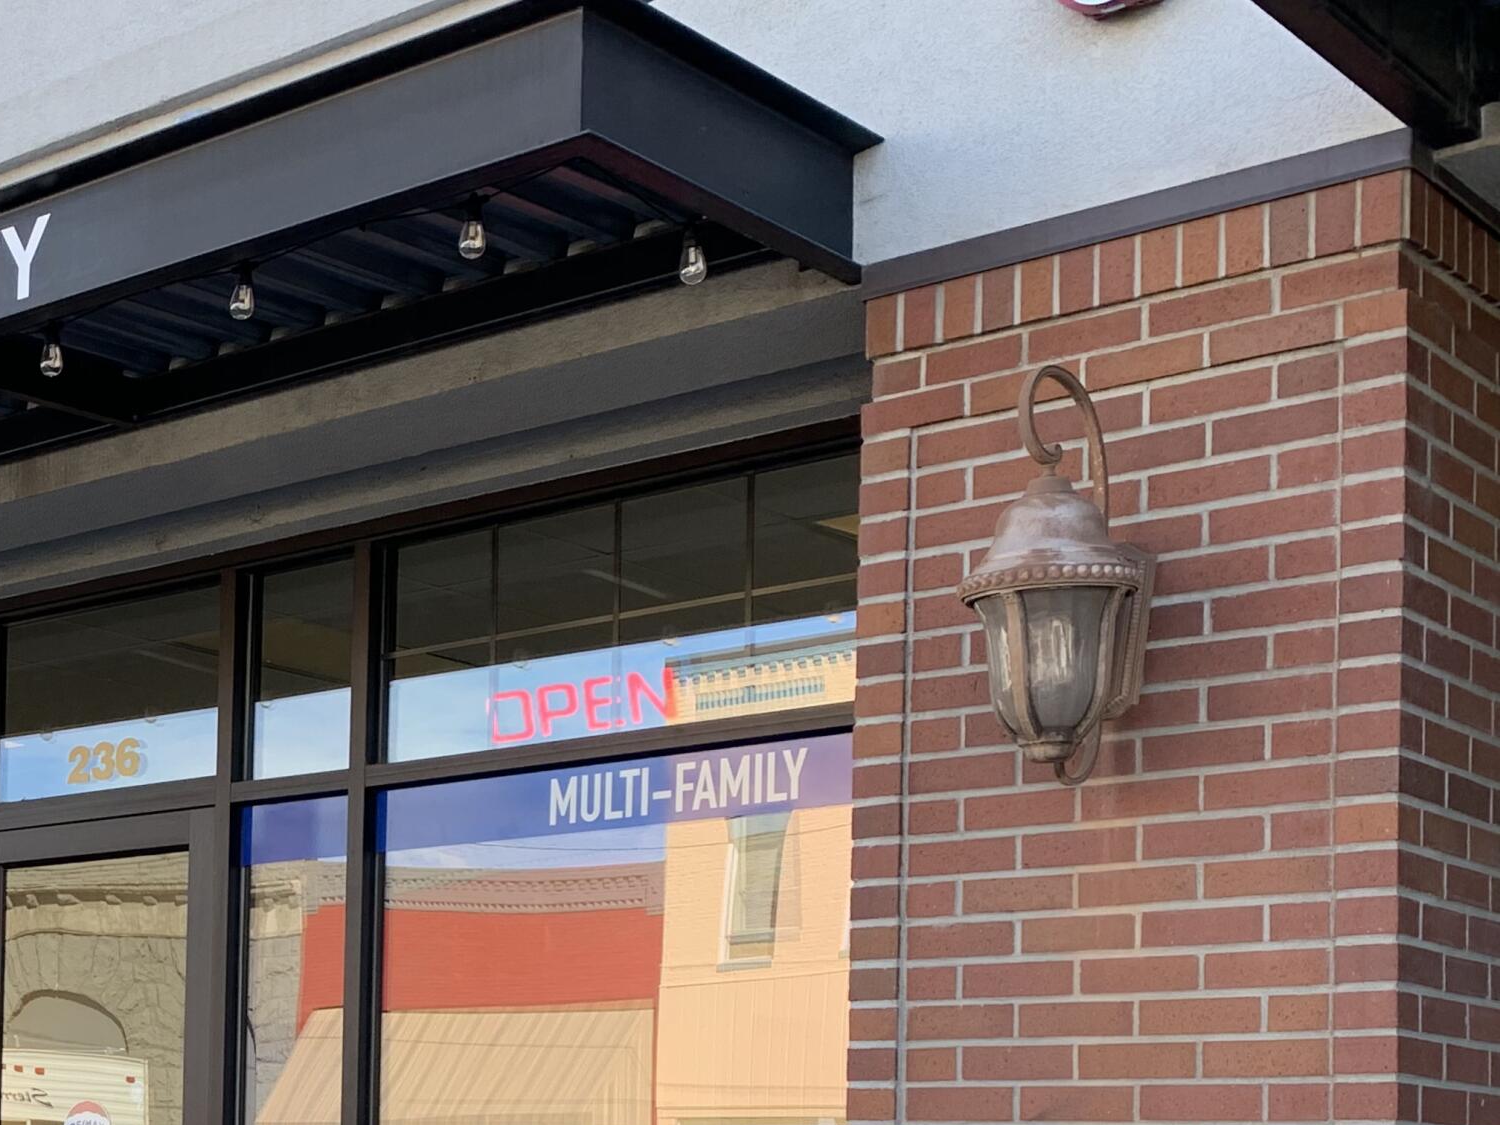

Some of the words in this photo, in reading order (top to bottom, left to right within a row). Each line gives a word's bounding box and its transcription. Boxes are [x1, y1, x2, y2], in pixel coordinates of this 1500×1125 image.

[487, 667, 677, 744] OPEN
[67, 737, 141, 785] 236
[548, 748, 808, 827] MULTI-FAMILY
